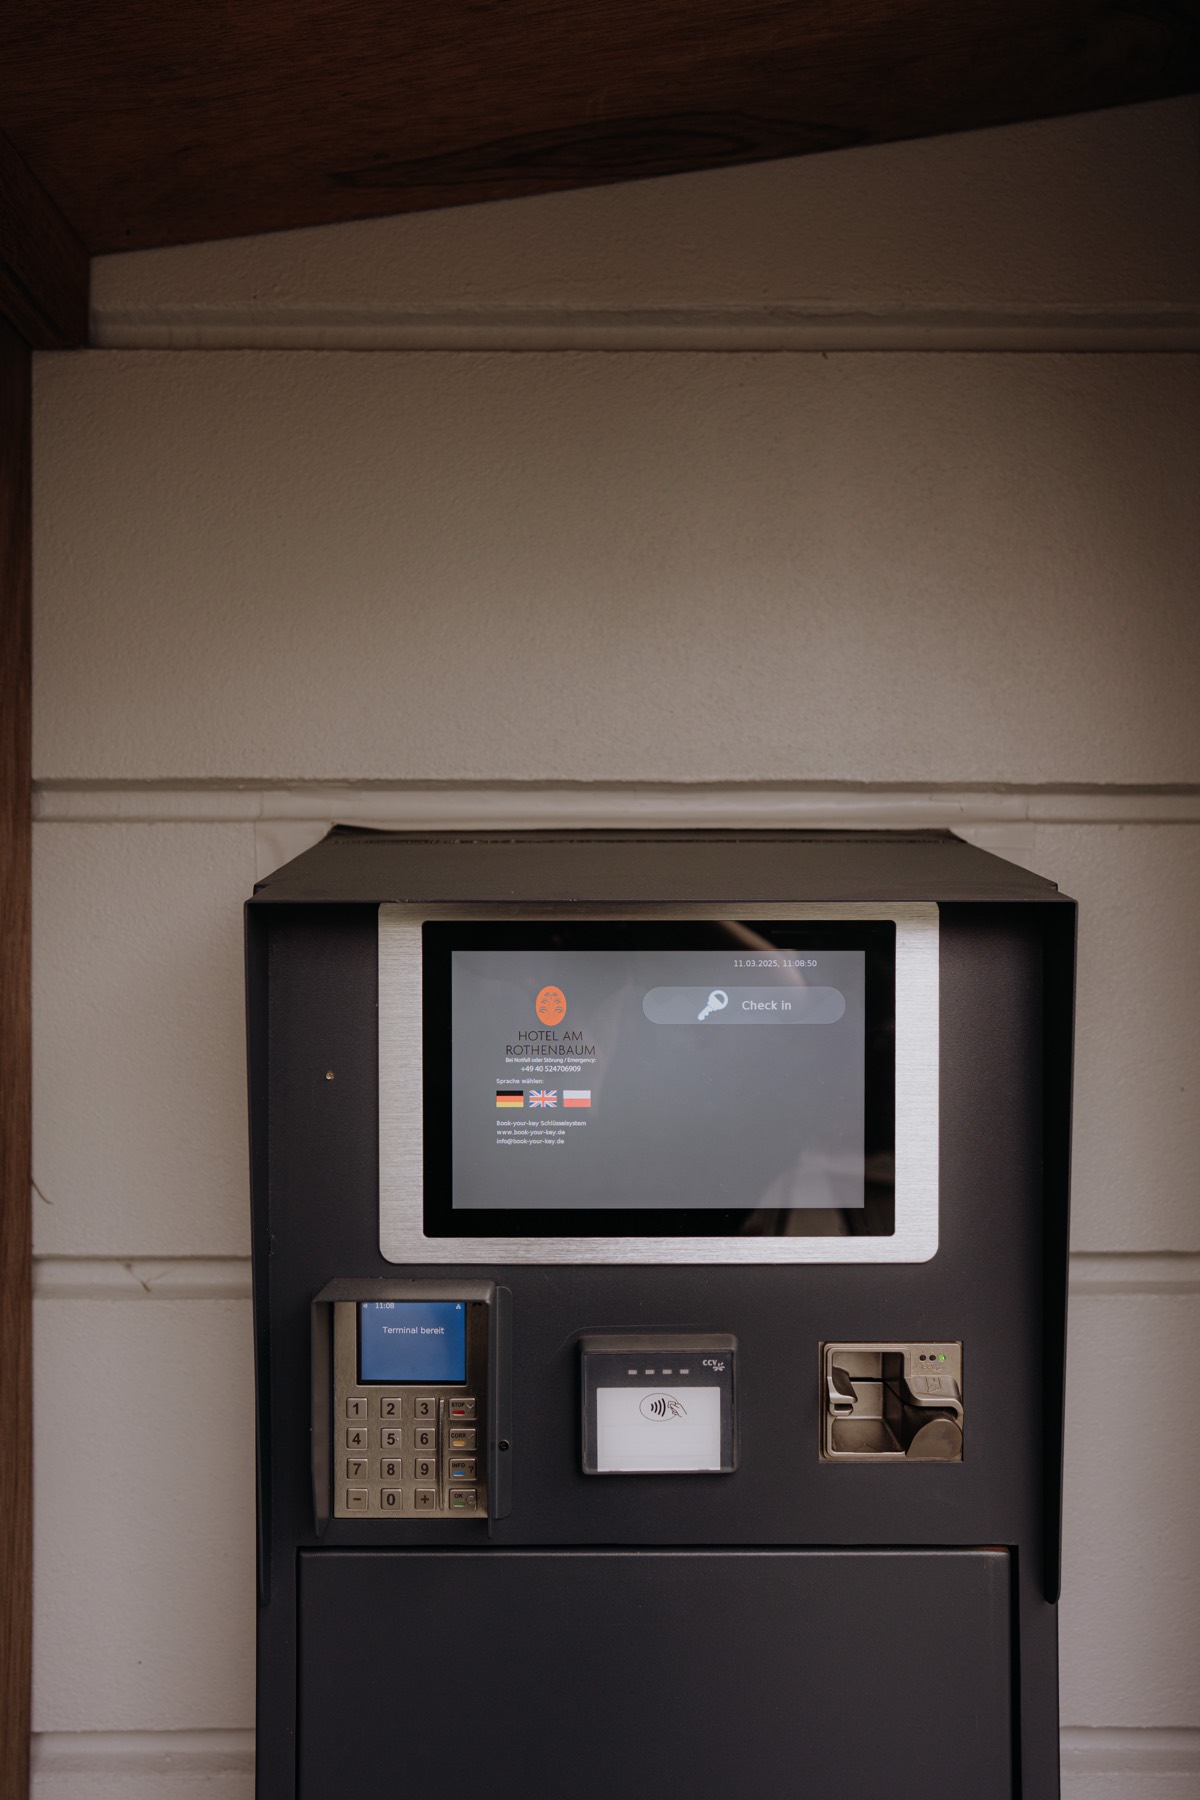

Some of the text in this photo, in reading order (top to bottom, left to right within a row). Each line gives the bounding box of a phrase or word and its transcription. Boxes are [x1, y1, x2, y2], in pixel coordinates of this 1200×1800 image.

[733, 959, 818, 968] 11.03.2025, 11:08:50
[741, 1000, 792, 1011] Check in
[518, 1031, 583, 1041] HOTEL AM
[505, 1045, 596, 1056] ROTHENBAUM
[544, 1065, 581, 1073] 524706909
[521, 1077, 545, 1085] wählen:
[382, 1326, 445, 1334] Terminal bereit
[352, 1403, 359, 1415] 1
[386, 1403, 395, 1415] 2
[420, 1403, 429, 1415] 3
[352, 1433, 361, 1445] 4
[386, 1433, 395, 1445] 5
[420, 1433, 429, 1445] 6
[353, 1463, 361, 1475] 7
[386, 1463, 395, 1475] 8
[420, 1463, 429, 1475] 9
[468, 1465, 474, 1474] ?
[386, 1493, 396, 1506] 0
